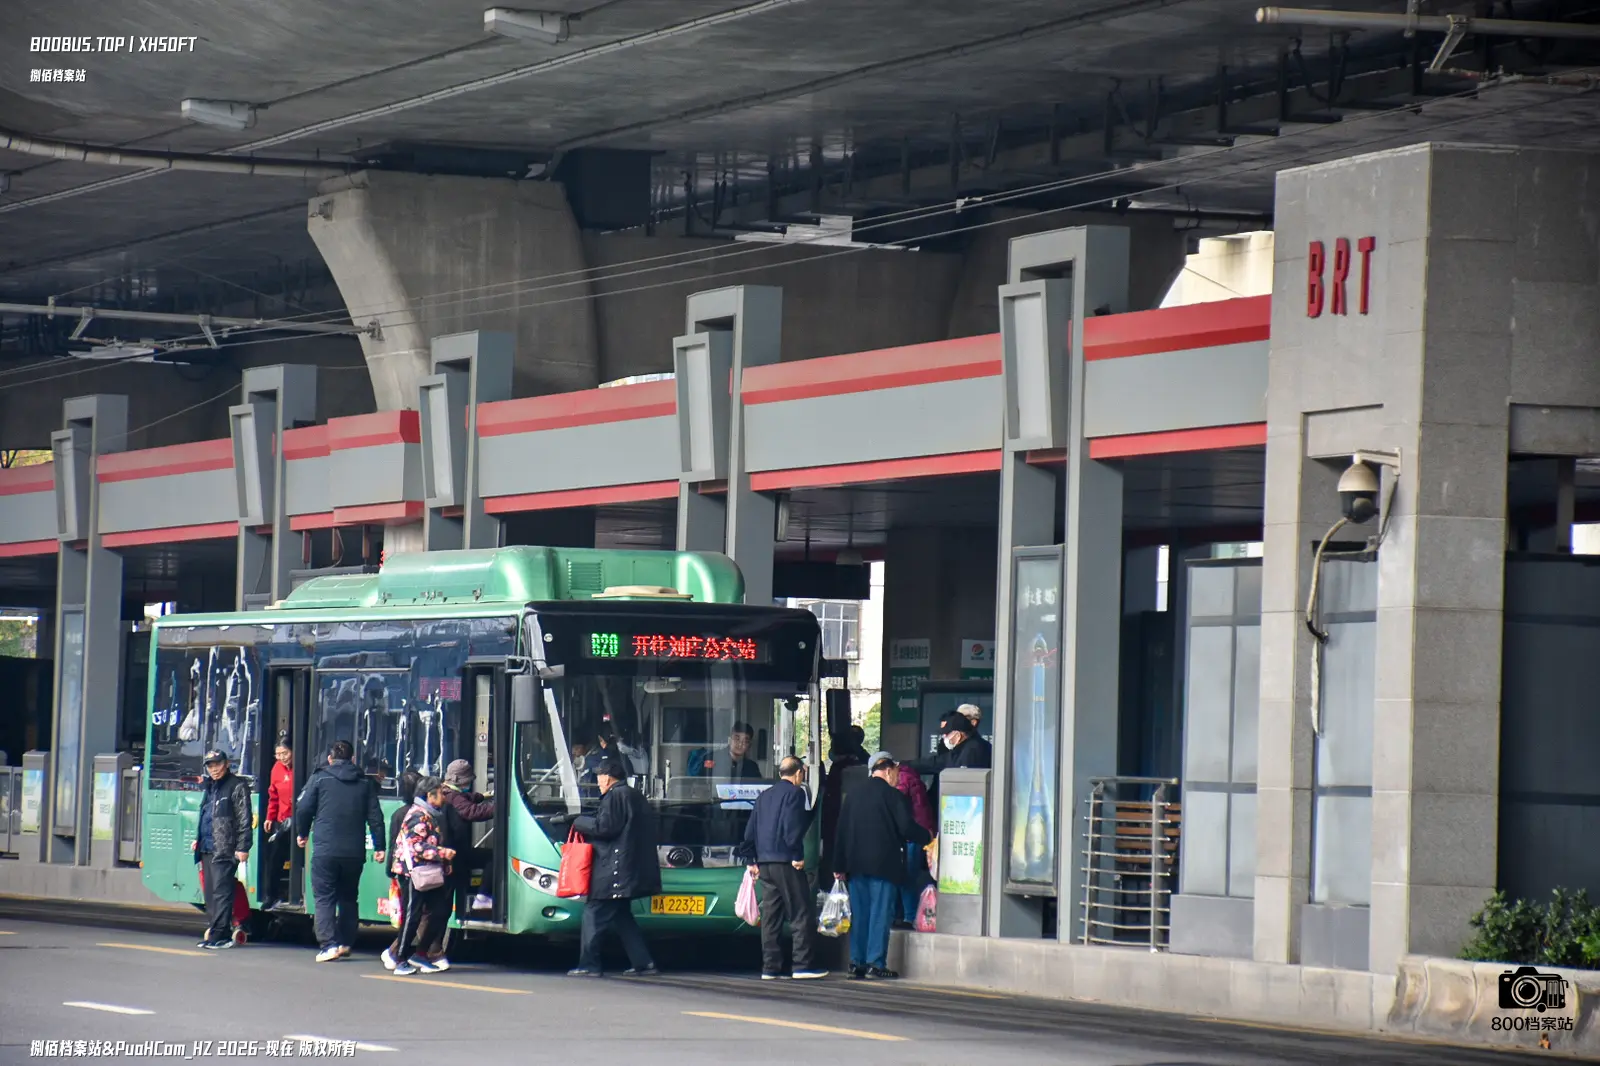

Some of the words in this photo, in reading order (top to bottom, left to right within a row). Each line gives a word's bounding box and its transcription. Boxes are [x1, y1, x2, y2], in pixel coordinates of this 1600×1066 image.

[1307, 236, 1376, 318] BRT
[632, 634, 757, 661] 开往刘庄公交站
